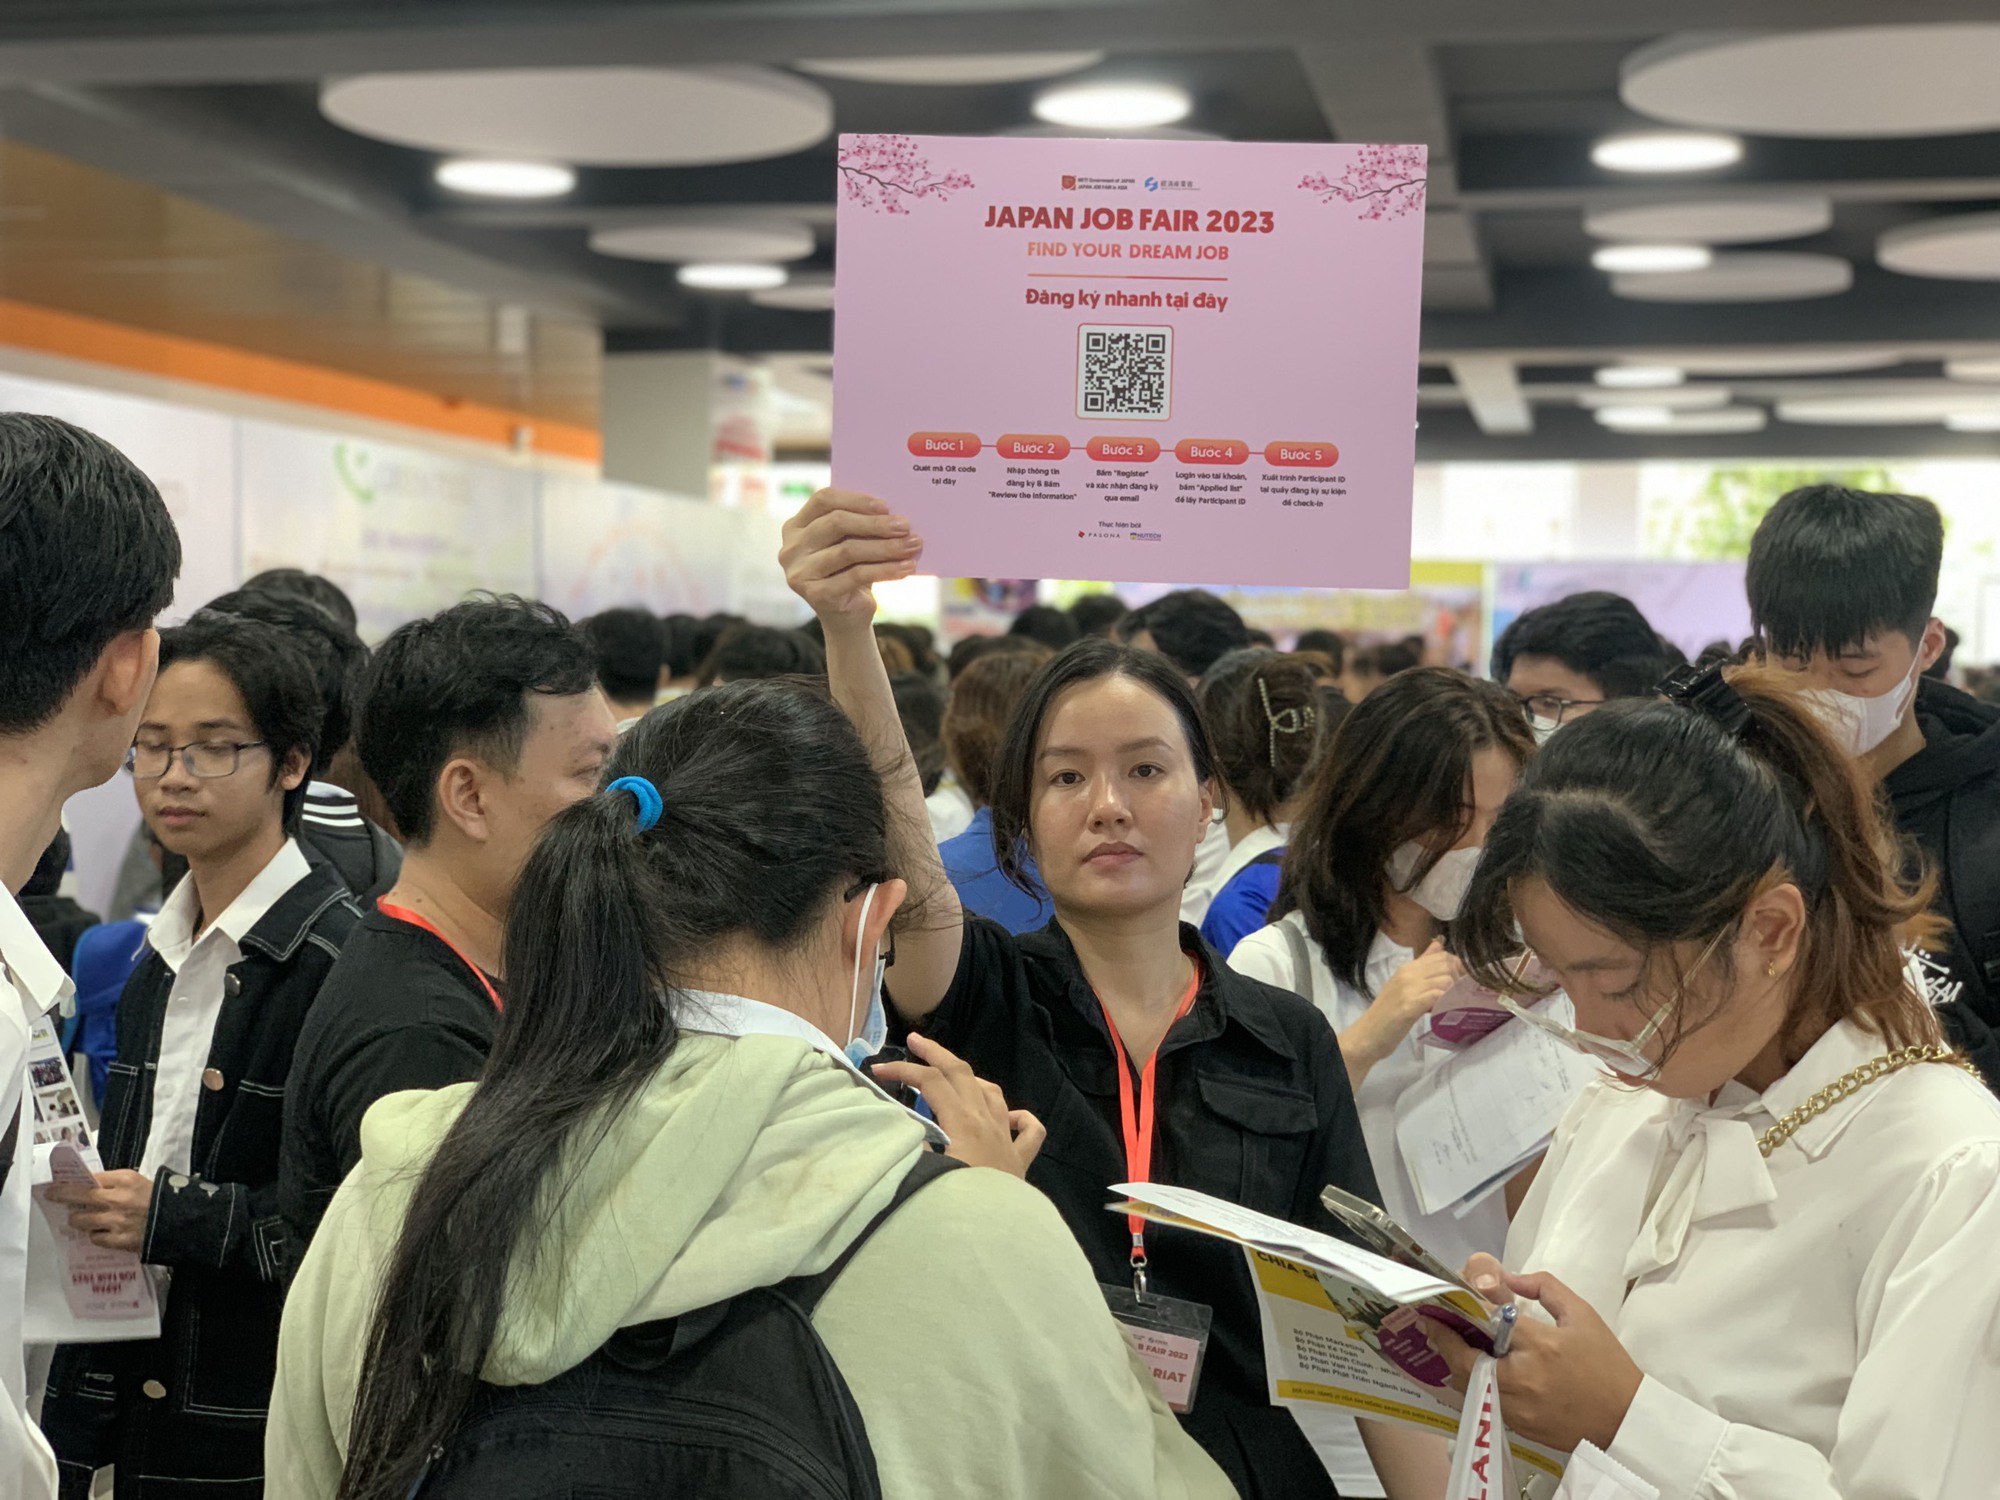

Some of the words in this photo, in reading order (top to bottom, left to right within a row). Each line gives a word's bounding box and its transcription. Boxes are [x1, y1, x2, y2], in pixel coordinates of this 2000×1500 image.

[985, 205, 1074, 230] JAPAN
[1080, 207, 1134, 231] JOB
[1139, 208, 1200, 232] FAIR
[1206, 209, 1275, 234] 2023
[1027, 242, 1068, 257] FIND
[1072, 243, 1122, 258] YOUR
[1129, 244, 1192, 259] DREAM
[1195, 245, 1229, 260] JOB
[1105, 290, 1162, 308] nhanh
[1166, 291, 1189, 311] tại
[1193, 291, 1229, 312] đây
[925, 439, 955, 451] Bước
[959, 440, 964, 451] 1
[1013, 441, 1043, 454] Bước
[1047, 443, 1056, 454] 2
[1102, 443, 1132, 456] Bước
[1136, 445, 1144, 456] 3
[1190, 446, 1221, 458] Bước
[1224, 447, 1233, 458] 4
[1280, 448, 1311, 461] Bước
[1314, 450, 1322, 461] 5
[945, 465, 957, 473] QR
[1007, 467, 1026, 476] Nhập
[1027, 467, 1049, 477] thông
[1050, 468, 1060, 476] tin
[1114, 470, 1149, 478] "Register"
[1175, 471, 1195, 480] Login
[1298, 475, 1337, 483] Participant
[932, 477, 941, 486] tại
[942, 477, 957, 486] đây
[1110, 482, 1128, 491] nhận
[1197, 484, 1228, 492] "Applied
[1260, 486, 1269, 495] tại
[1331, 488, 1347, 496] kiện
[1019, 491, 1031, 499] the
[1186, 496, 1197, 504] lấy
[1198, 497, 1237, 505] Participant
[1282, 499, 1291, 507] để
[1115, 521, 1129, 529] hiện
[1325, 1336, 1365, 1354] Marketing
[1146, 1345, 1166, 1355] FAIR
[1168, 1349, 1189, 1360] 2023
